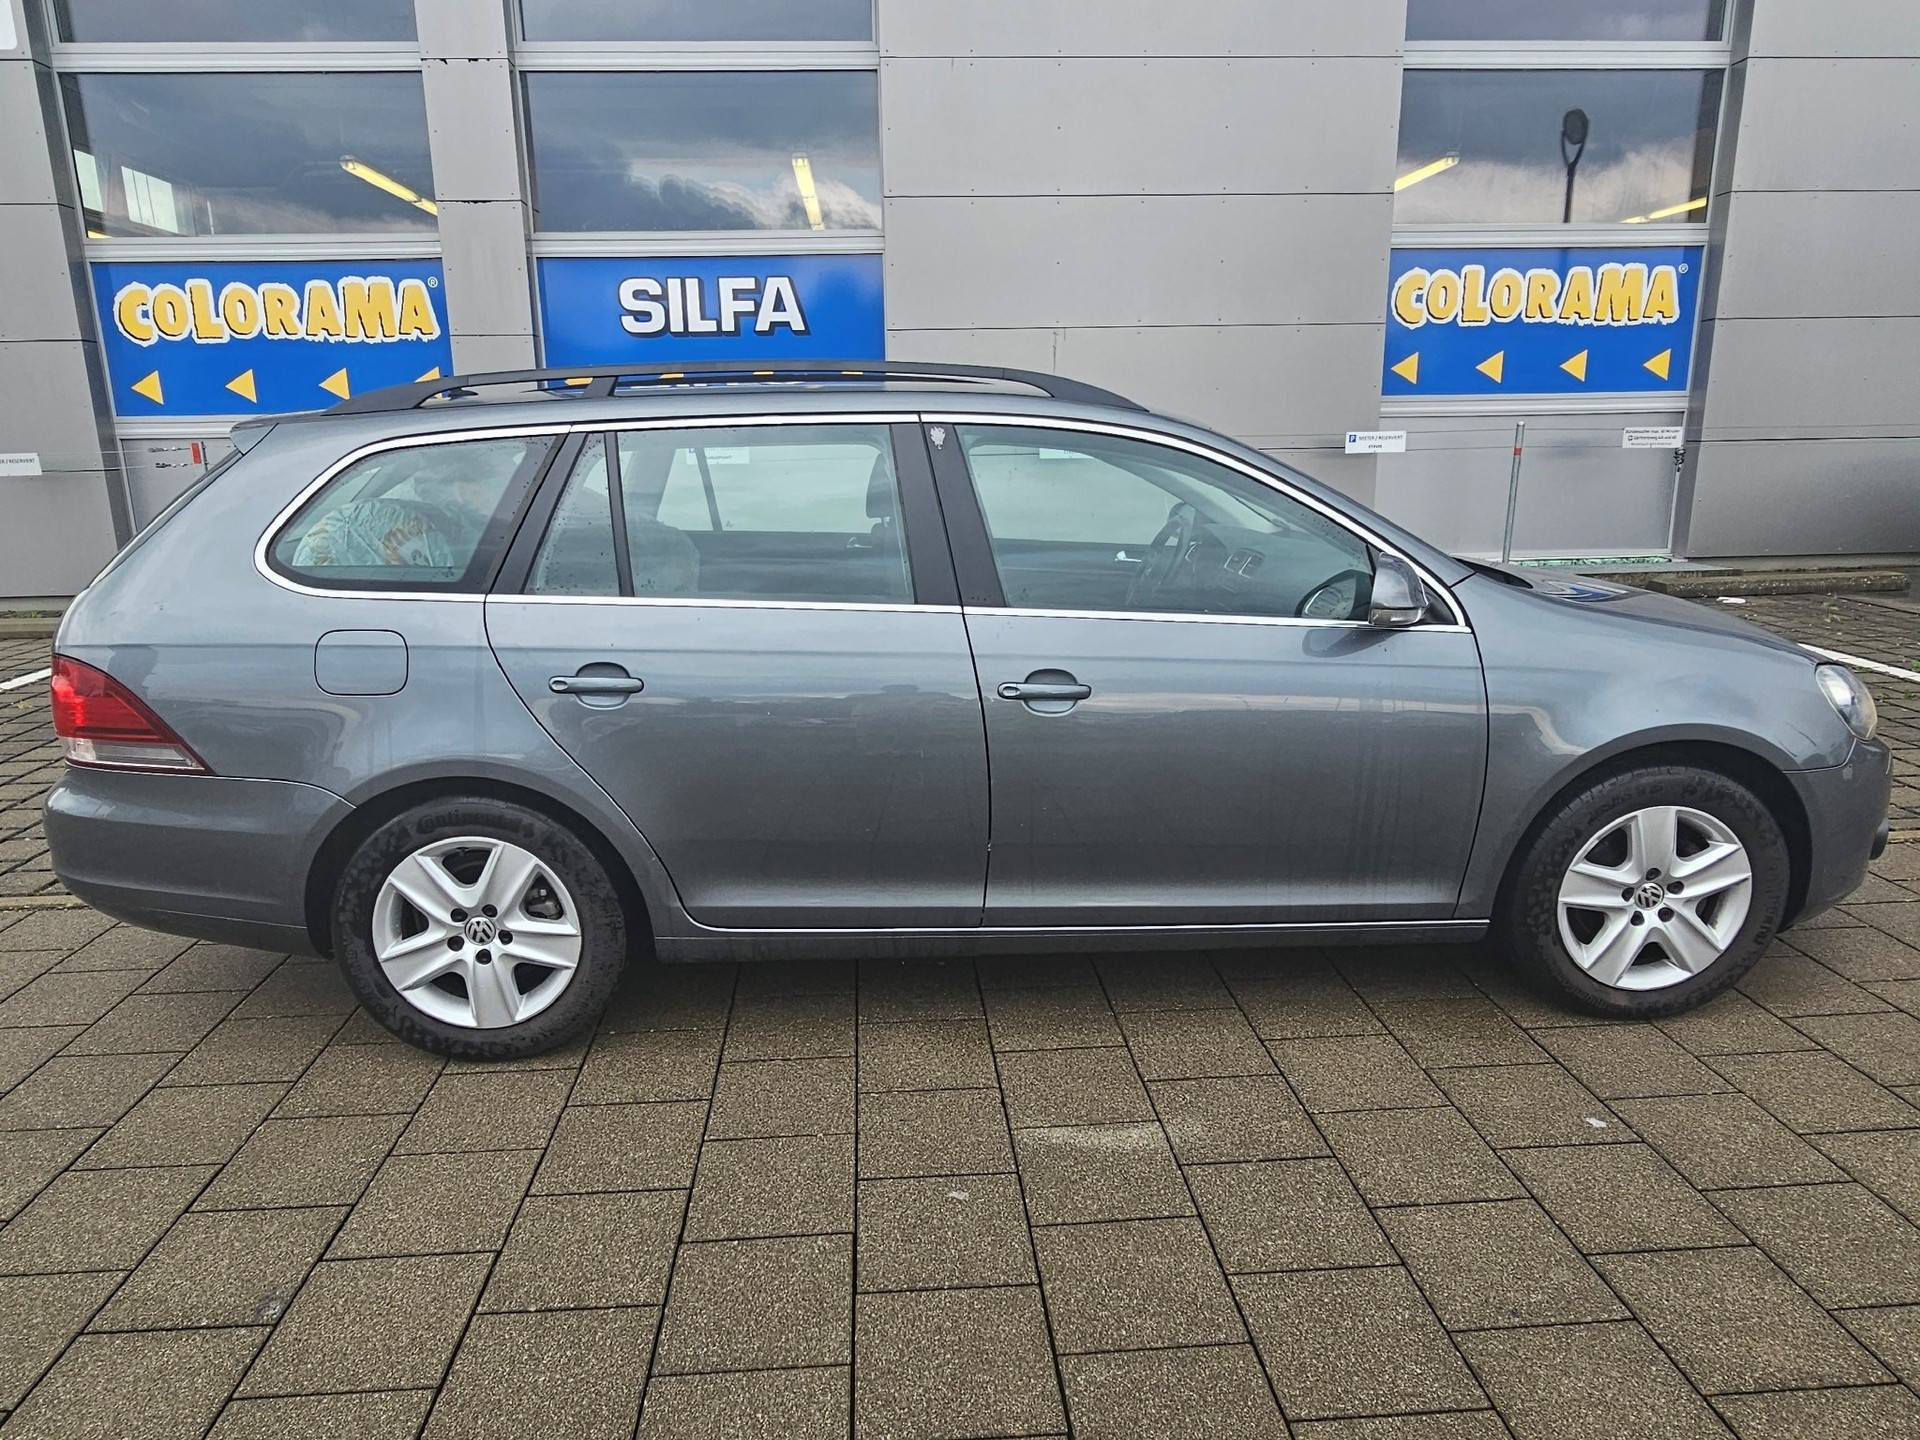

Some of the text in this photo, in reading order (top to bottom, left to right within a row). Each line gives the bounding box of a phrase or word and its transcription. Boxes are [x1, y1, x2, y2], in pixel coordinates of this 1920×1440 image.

[115, 278, 438, 344] COLORAMA
[619, 276, 809, 335] SILFA
[1393, 265, 1678, 327] COLORAMA
